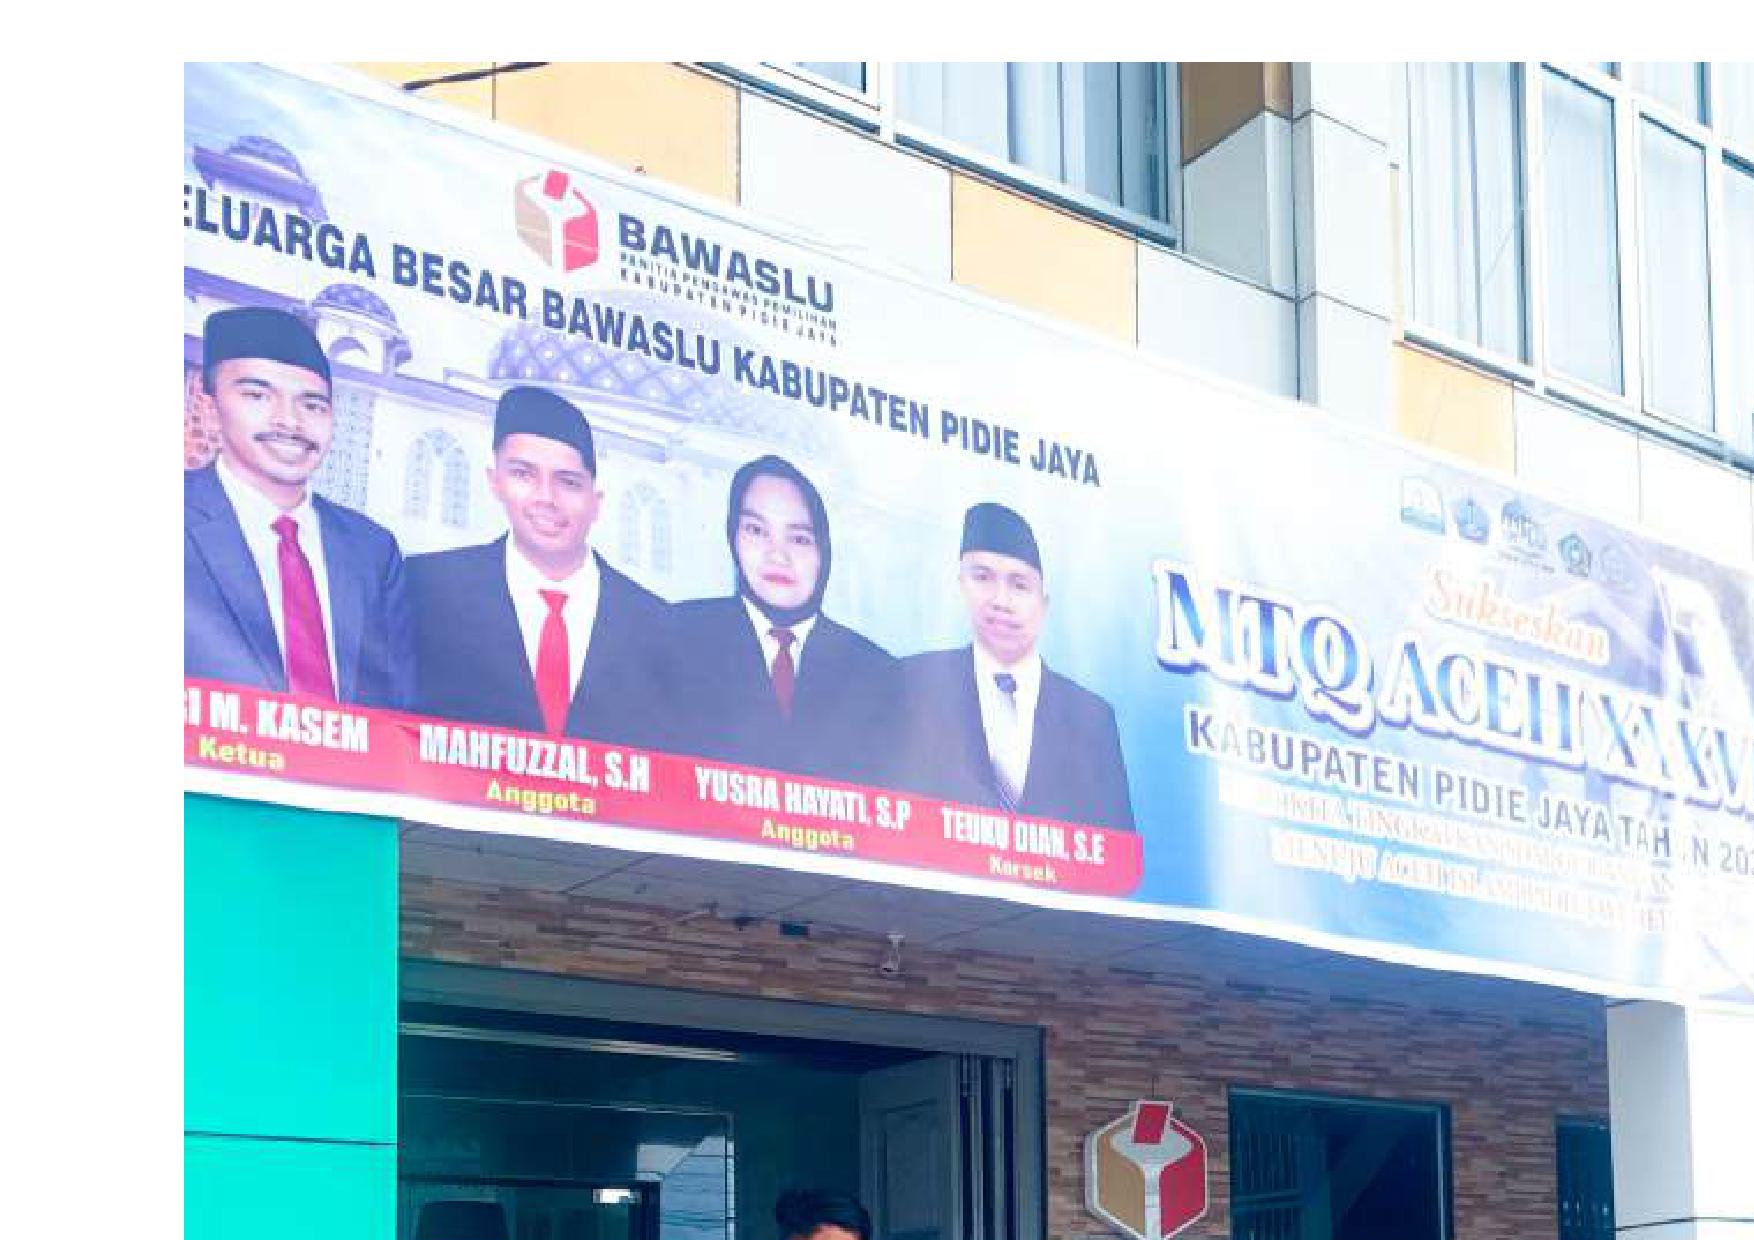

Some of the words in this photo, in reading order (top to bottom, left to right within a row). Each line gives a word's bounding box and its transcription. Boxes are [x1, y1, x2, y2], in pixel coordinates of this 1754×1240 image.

[618, 213, 834, 313] BAWASLU
[392, 243, 527, 321] BESAR
[542, 288, 721, 375] BAWASLU
[733, 346, 929, 439] KABUPATEN
[940, 409, 1021, 464] PIDIE
[1030, 438, 1101, 488] JAYA
[1424, 565, 1605, 662] Sukseskan
[1150, 561, 1376, 738] MTQ
[1376, 628, 1587, 773] ACEH
[184, 686, 201, 727] I
[209, 690, 248, 735] M.
[257, 697, 370, 754] KASEM
[199, 735, 286, 771] Ketua
[419, 723, 599, 788] MAHFUZZAL,
[604, 750, 650, 793] S.H
[1190, 710, 1418, 798] KABUPATEN
[1436, 771, 1526, 823] PIDIE
[1538, 797, 1610, 843] JAYA
[487, 778, 595, 815] Anggota
[695, 764, 781, 812] YUSRA
[876, 796, 911, 832] S.P
[761, 819, 855, 850] Anggota
[941, 808, 1010, 852] TEUKU
[1074, 830, 1106, 865] S.E
